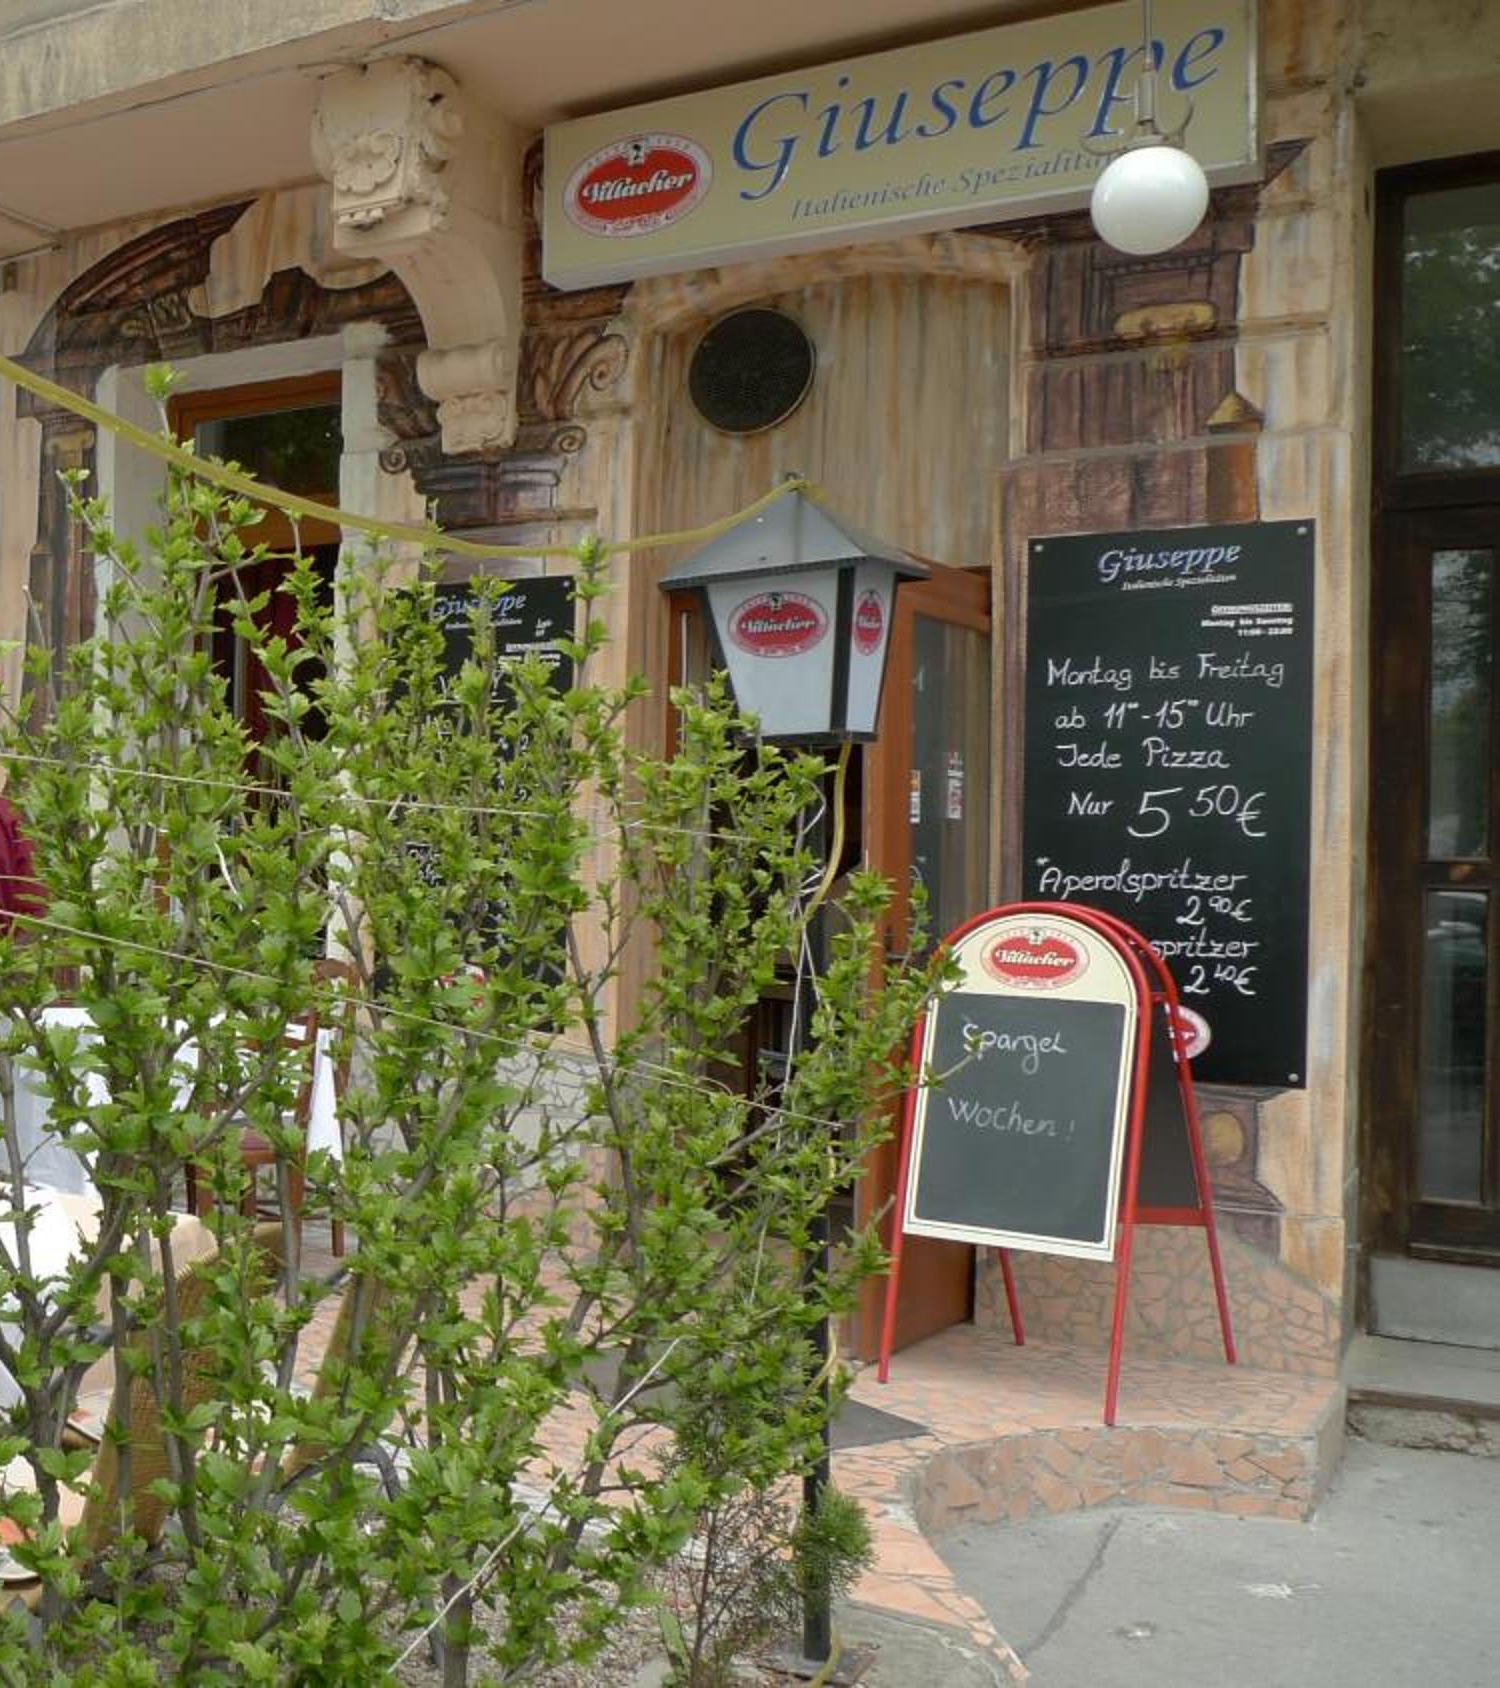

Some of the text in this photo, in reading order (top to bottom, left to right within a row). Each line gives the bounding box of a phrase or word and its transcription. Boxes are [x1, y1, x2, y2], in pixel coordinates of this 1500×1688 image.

[731, 26, 1226, 202] Giuseppe
[1098, 545, 1242, 583] Giuseppe
[1047, 651, 1285, 692] Montag bis Freitag
[1055, 705, 1087, 729] ab
[1206, 702, 1257, 729] Uhr
[1055, 736, 1231, 769] Jede Pizza
[1067, 791, 1114, 817] Nur
[1039, 857, 1248, 902] Aperolspritzer
[961, 1022, 1068, 1075] Spargel
